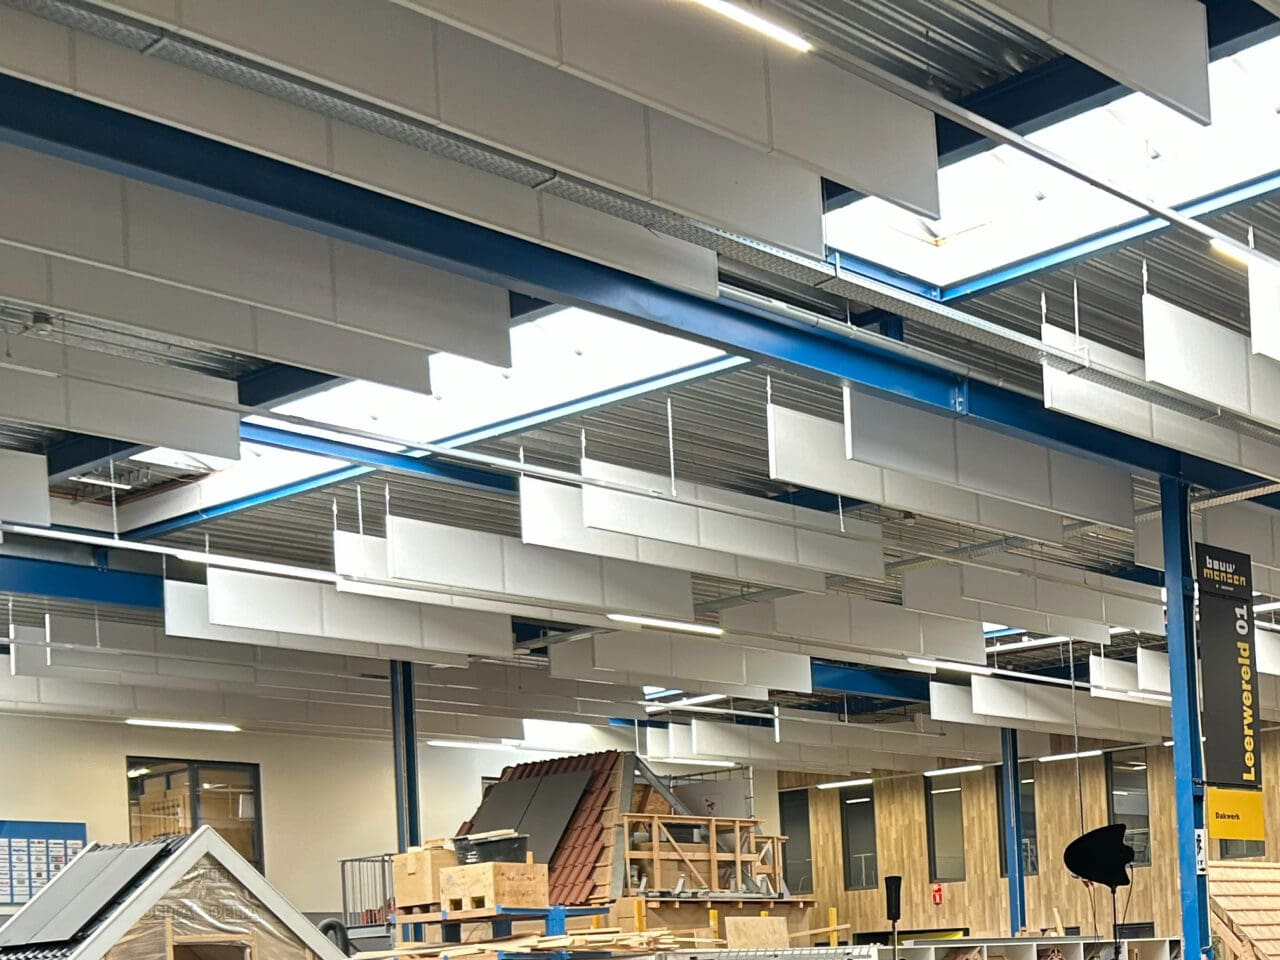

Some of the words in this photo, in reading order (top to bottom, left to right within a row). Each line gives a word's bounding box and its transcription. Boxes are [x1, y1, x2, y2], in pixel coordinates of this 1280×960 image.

[1206, 555, 1236, 573] bouw
[1203, 568, 1246, 586] mensen
[1234, 604, 1249, 635] 01
[1237, 642, 1255, 781] Leerwereld
[1215, 812, 1240, 820] Dakwerk
